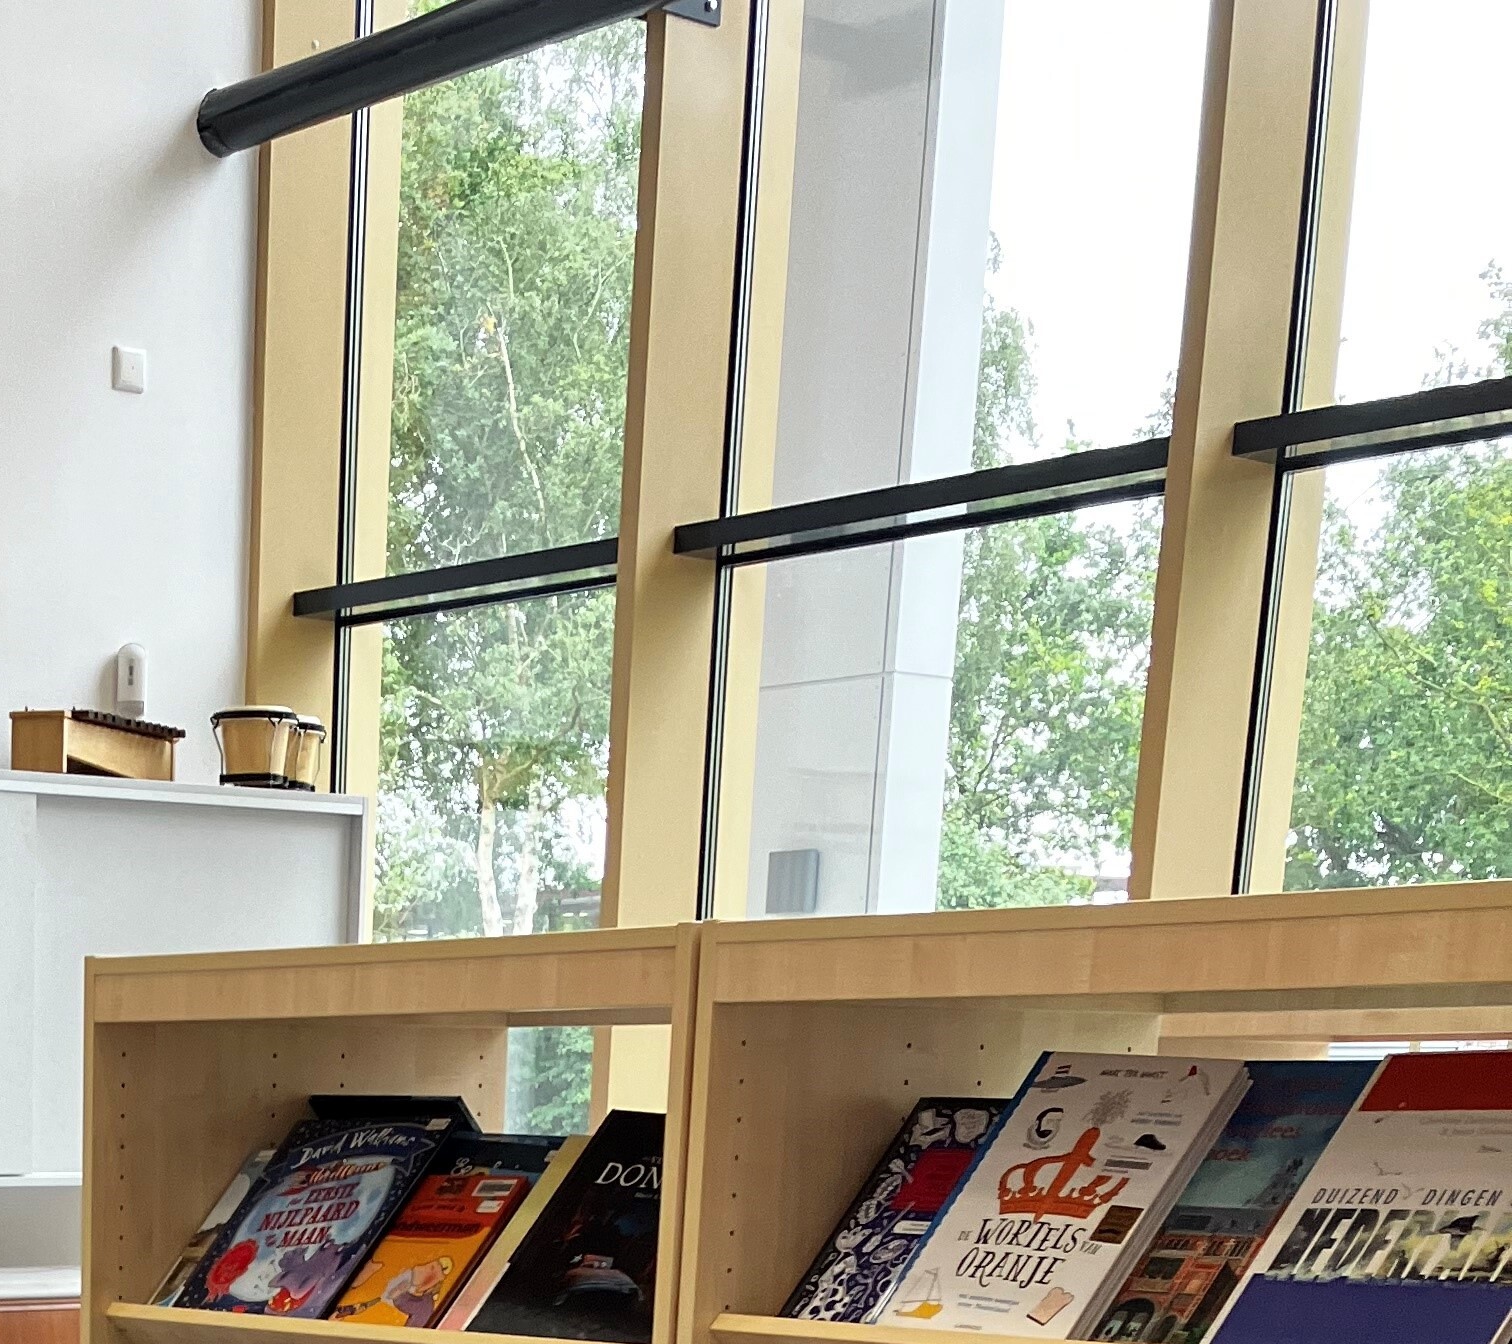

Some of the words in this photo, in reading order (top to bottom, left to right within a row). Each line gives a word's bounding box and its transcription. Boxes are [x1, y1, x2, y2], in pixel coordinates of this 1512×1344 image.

[1312, 1187, 1400, 1205] DUIZEND
[1422, 1189, 1503, 1206] DINGEN
[258, 1200, 360, 1232] NIJLPAARD
[277, 1226, 332, 1248] MAAN
[957, 1231, 971, 1241] DE
[974, 1218, 1086, 1253] WORTELS
[955, 1247, 1066, 1288] ORANJE
